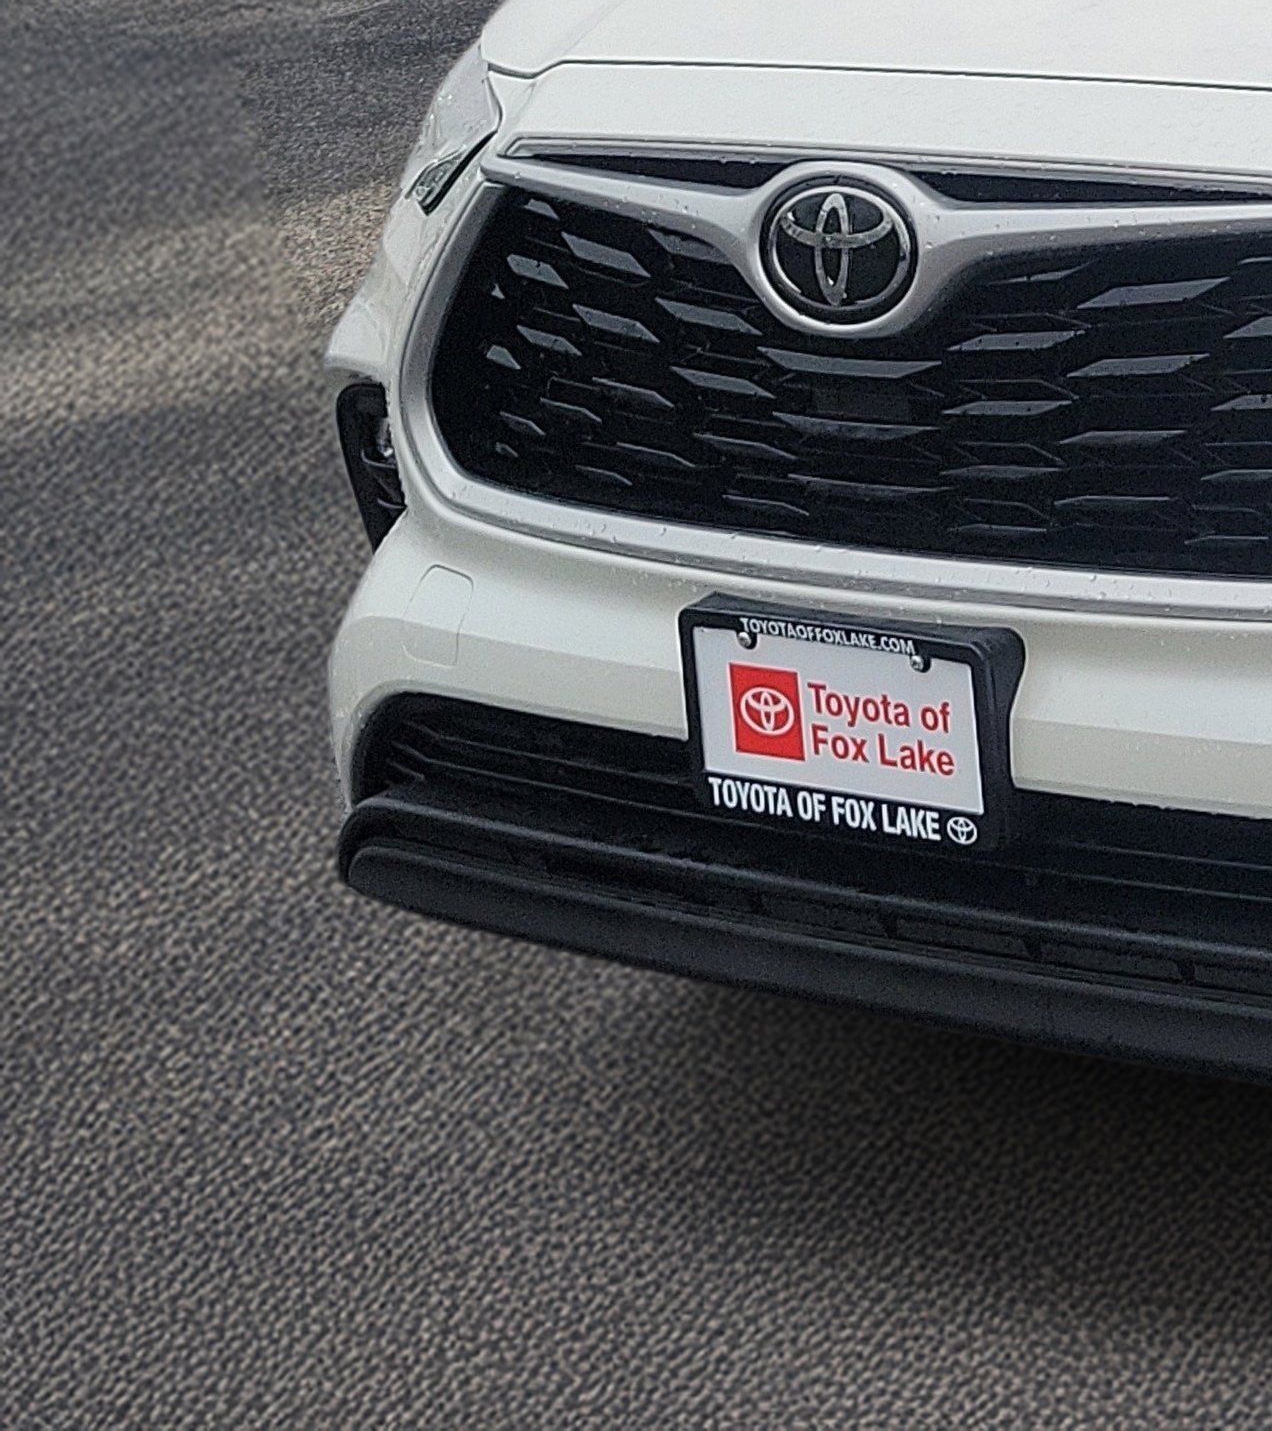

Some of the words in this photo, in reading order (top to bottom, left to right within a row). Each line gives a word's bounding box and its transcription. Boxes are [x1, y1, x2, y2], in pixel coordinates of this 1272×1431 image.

[739, 617, 916, 655] TOYOTAOFFOXLAKE.COM
[807, 682, 911, 728] Toyota
[920, 701, 951, 734] of
[811, 724, 869, 763] Fox
[878, 733, 956, 777] Lake
[708, 776, 794, 818] TOYOTA
[797, 790, 827, 823] OF
[831, 796, 877, 831] FOX
[882, 804, 942, 841] LAKE
